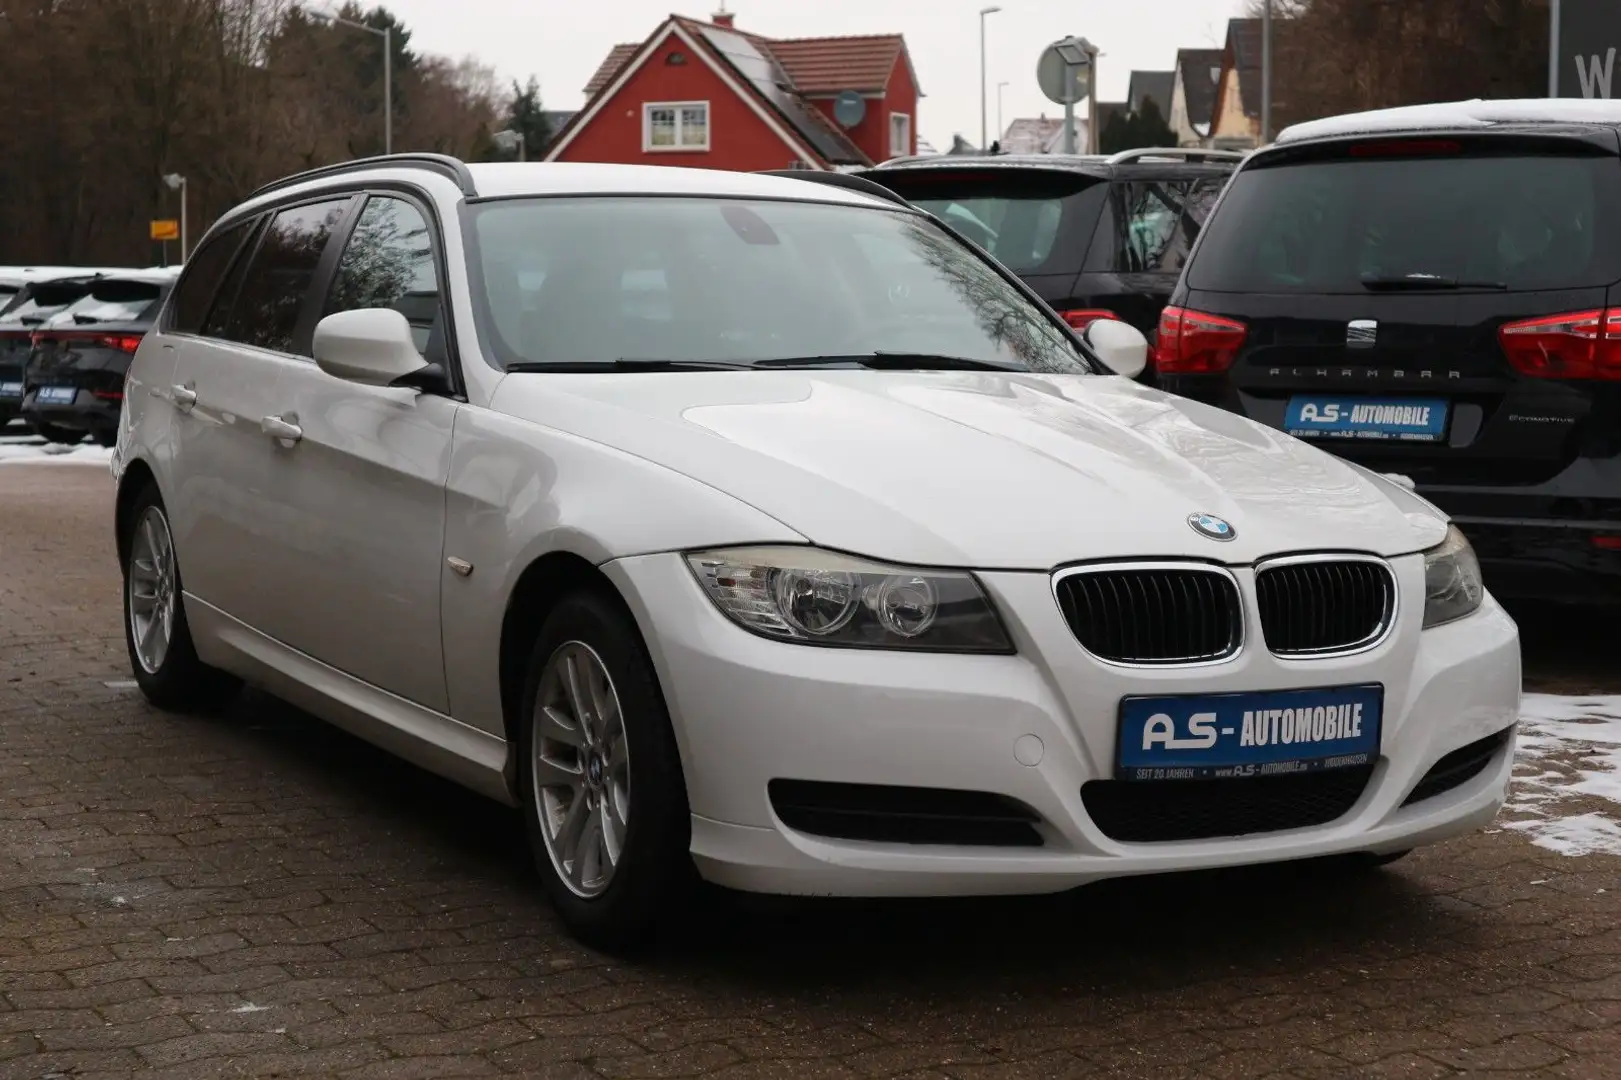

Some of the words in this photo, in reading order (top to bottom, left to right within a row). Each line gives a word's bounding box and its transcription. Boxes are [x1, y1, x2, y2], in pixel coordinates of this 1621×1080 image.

[1269, 368, 1460, 379] ALHAMBRA
[1136, 768, 1153, 780] SEIT
[1154, 768, 1165, 779] 20
[1165, 767, 1194, 779] JAHREN
